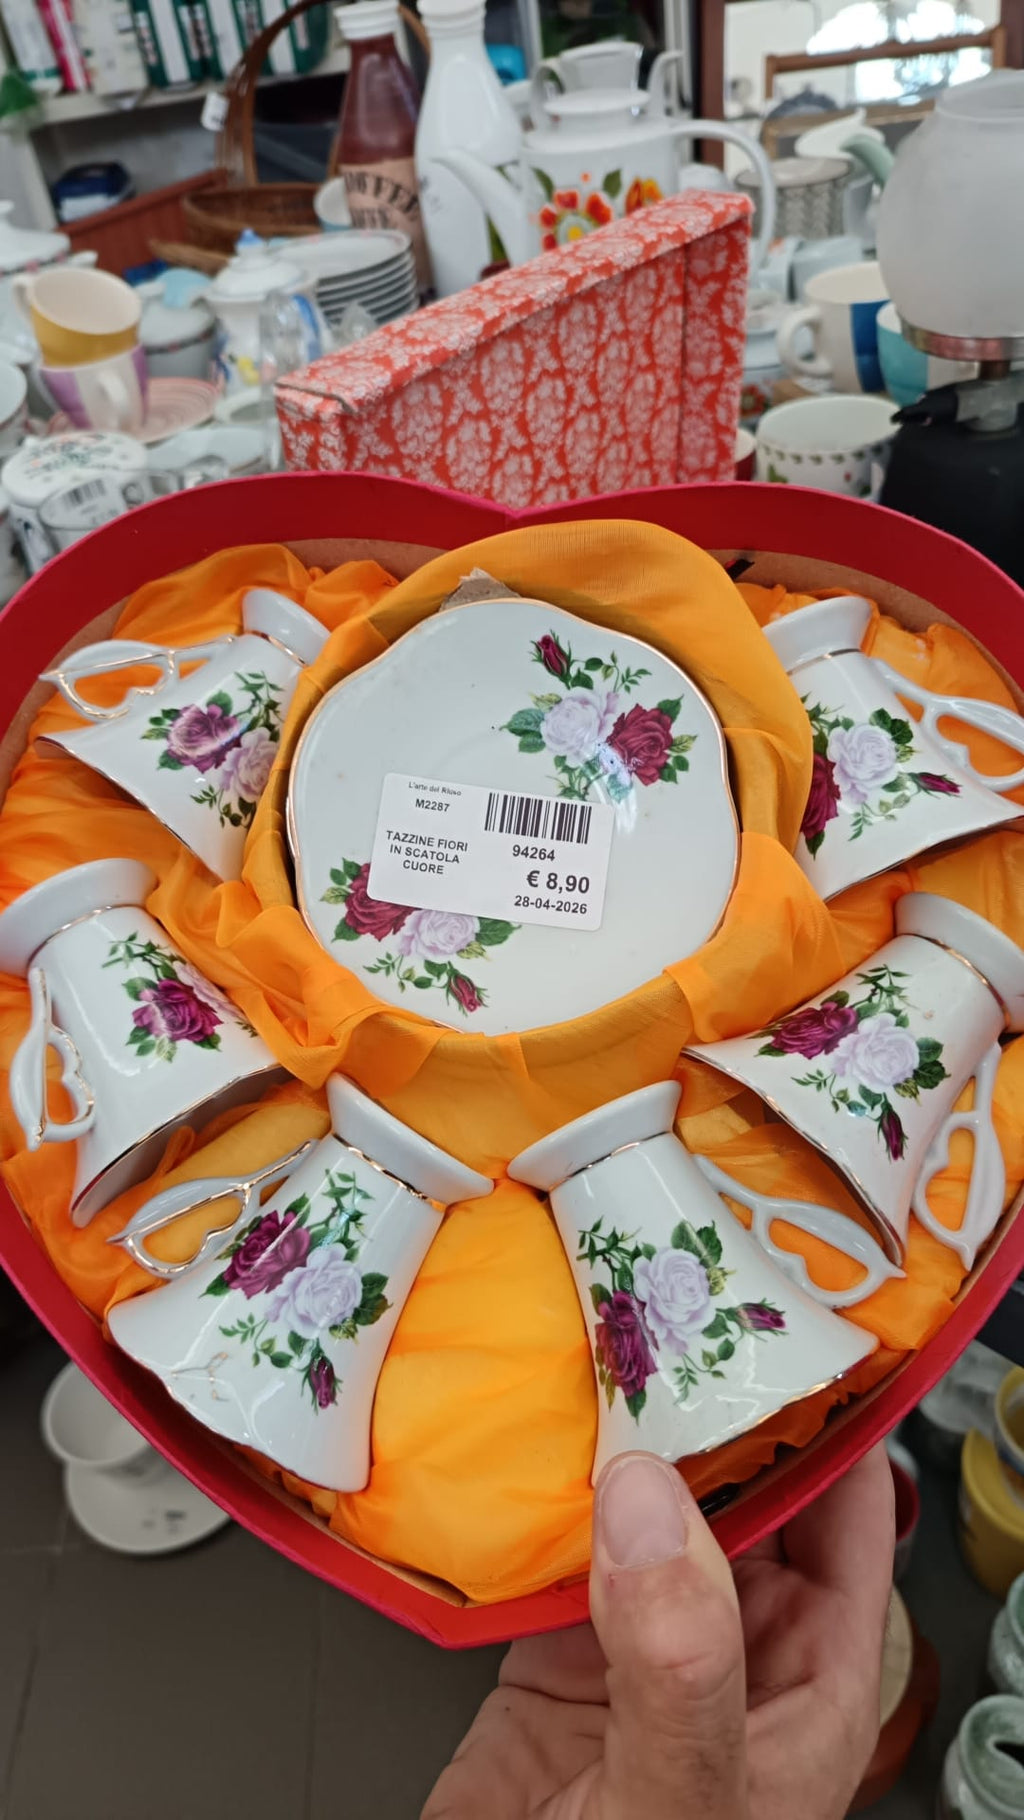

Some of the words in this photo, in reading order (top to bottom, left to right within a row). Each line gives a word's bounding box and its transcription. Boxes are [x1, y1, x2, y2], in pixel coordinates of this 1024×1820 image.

[408, 781, 428, 791] L'arte
[415, 798, 450, 812] M2287
[386, 830, 435, 847] TAZZINE
[437, 838, 468, 852] FIORI
[389, 843, 402, 854] IN
[404, 846, 460, 864] SCATOLA
[512, 844, 555, 861] 94264
[402, 859, 444, 875] CUORE
[526, 870, 540, 888] €
[546, 872, 590, 894] 8,90
[514, 895, 588, 914] 28-04-2026
